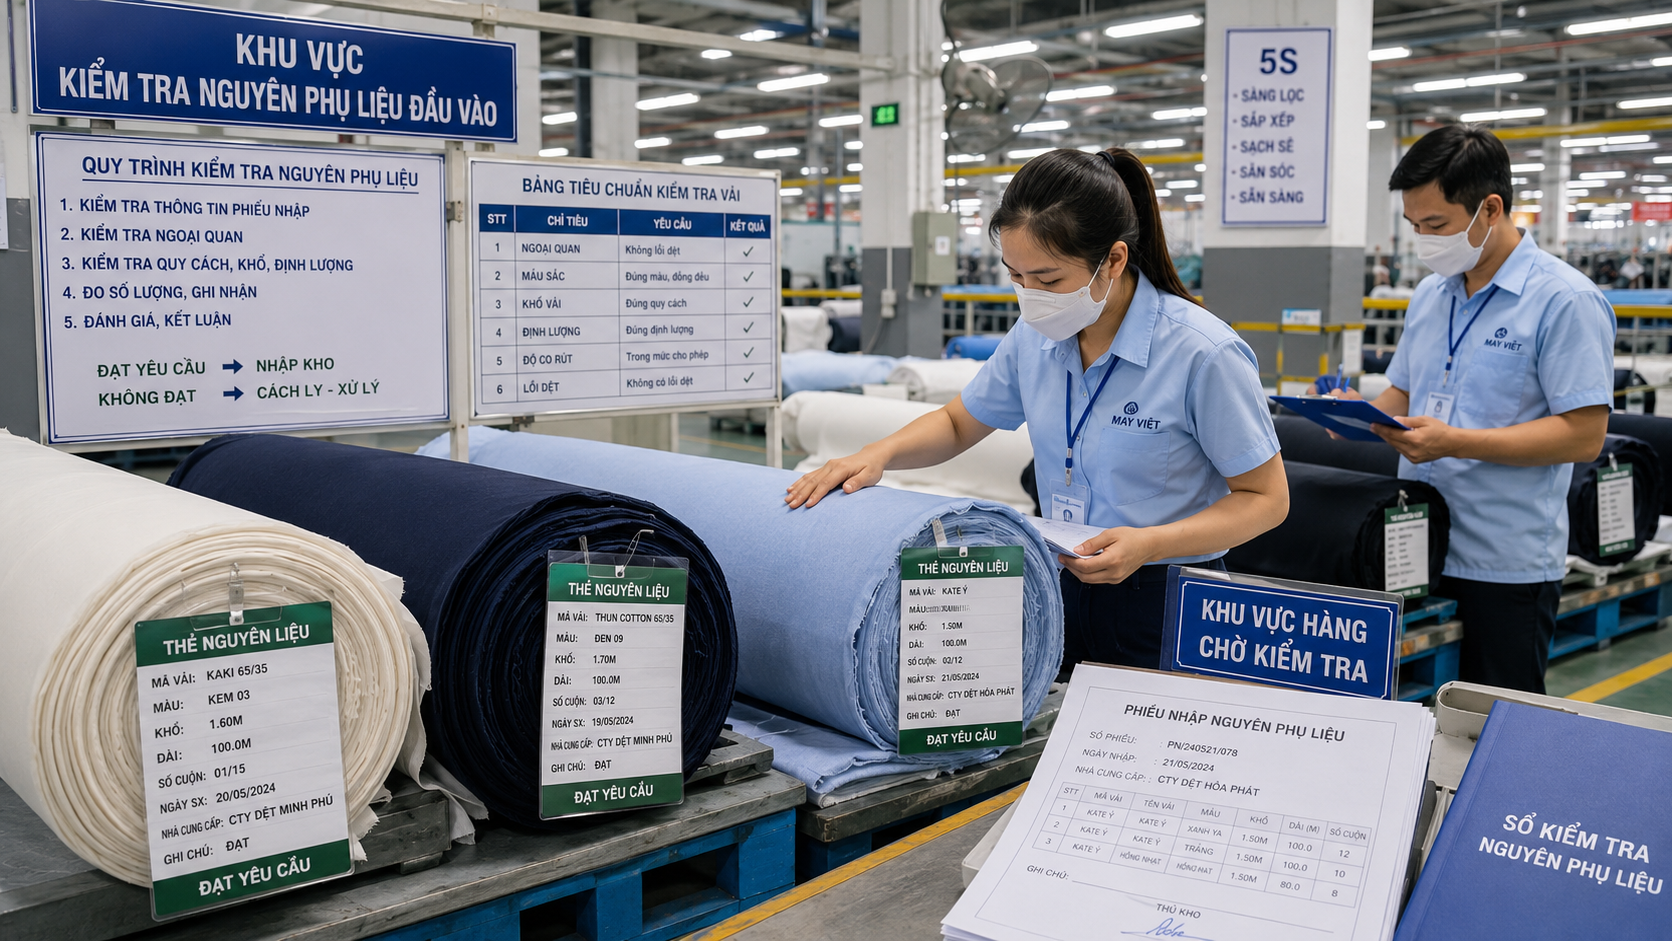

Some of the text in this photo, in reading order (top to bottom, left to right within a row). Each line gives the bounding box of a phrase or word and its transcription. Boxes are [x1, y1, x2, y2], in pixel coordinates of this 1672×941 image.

[236, 33, 364, 79] KHU VỰC
[1260, 48, 1298, 74] 5S
[59, 57, 497, 128] KIỂM TRA NGUYÊN PHỤ LIỆU ĐẦU VÀO
[1241, 86, 1304, 104] SÀNG LỌC
[1240, 140, 1274, 155] SẠCH
[82, 155, 419, 190] QUY TRÌNH KIỂM TRA NGUYÊN PHỤ LIỆU
[522, 175, 741, 202] BẢNG TIÊU CHUẨN KIỂM TRA VẢI
[60, 193, 310, 219] 1. KIỂM TRA THÔNG TIN PHIẾU NHẬP
[487, 213, 507, 225] STT
[61, 223, 243, 246] 2. KIỂM TRA NGOẠI QUAN
[522, 243, 581, 256] NGOẠI QUAN
[61, 252, 353, 274] 3. KIỂM TRA QUY CÁCH, KHỔ, ĐỊNH LƯỢNG
[63, 280, 257, 303] 4. ĐO SỐ LƯỢNG, GHI NHẬN
[64, 309, 232, 330] 5. ĐÁNH GIÁ, KẾT LUẬN
[522, 326, 581, 340] ĐỊNH LƯỢNG
[625, 325, 694, 337] Đúng định lượng
[1484, 338, 1502, 348] MAY
[522, 354, 536, 367] ĐỘ
[539, 354, 552, 365] CO
[626, 352, 650, 363] Trong
[672, 351, 687, 360] cho
[97, 357, 335, 380] ĐẠT YÊU CẦU NHẬP KHO
[99, 388, 159, 407] KHÔNG
[163, 390, 197, 407] ĐẠT
[257, 383, 300, 400] CÁCH
[304, 384, 323, 398] LY
[362, 379, 381, 395] LÝ
[1111, 415, 1134, 427] MAY
[942, 587, 961, 595] KATE
[595, 613, 675, 623] THUN COTTON 65/35
[1201, 598, 1368, 644] KHU VỰC HÀNG
[163, 623, 310, 655] THẺ NGUYÊN LIỆU
[594, 634, 624, 643] ĐEN 09
[593, 655, 617, 664] 1.70M
[1199, 634, 1369, 684] CHỜ KIỂM TRA
[206, 663, 268, 680] KAKI 65/35
[208, 690, 250, 705] KEM 03
[593, 696, 615, 706] 03/12
[209, 715, 243, 730] 1.60M
[1124, 704, 1346, 744] PHIẾU NHẬP NGUYÊN PHỤ LIỆU
[211, 738, 251, 754] 100.0M
[1167, 740, 1238, 757] PN/240521/078
[214, 763, 246, 778] 01/15
[1162, 759, 1214, 772] 21/05/2024
[215, 783, 276, 803] 20/05/2024
[228, 795, 334, 826] CTY DỆT MINH PHÚ
[225, 837, 250, 852] ĐẠT
[1502, 811, 1650, 864] SỔ KIỂM TRA
[1242, 834, 1350, 859] 1.50M 12
[1478, 836, 1663, 895] NGUYÊN PHỤ LIỆU
[199, 855, 311, 896] ĐẠT YÊU CẦU
[1334, 870, 1345, 879] 10
[1280, 881, 1300, 891] 80.0
